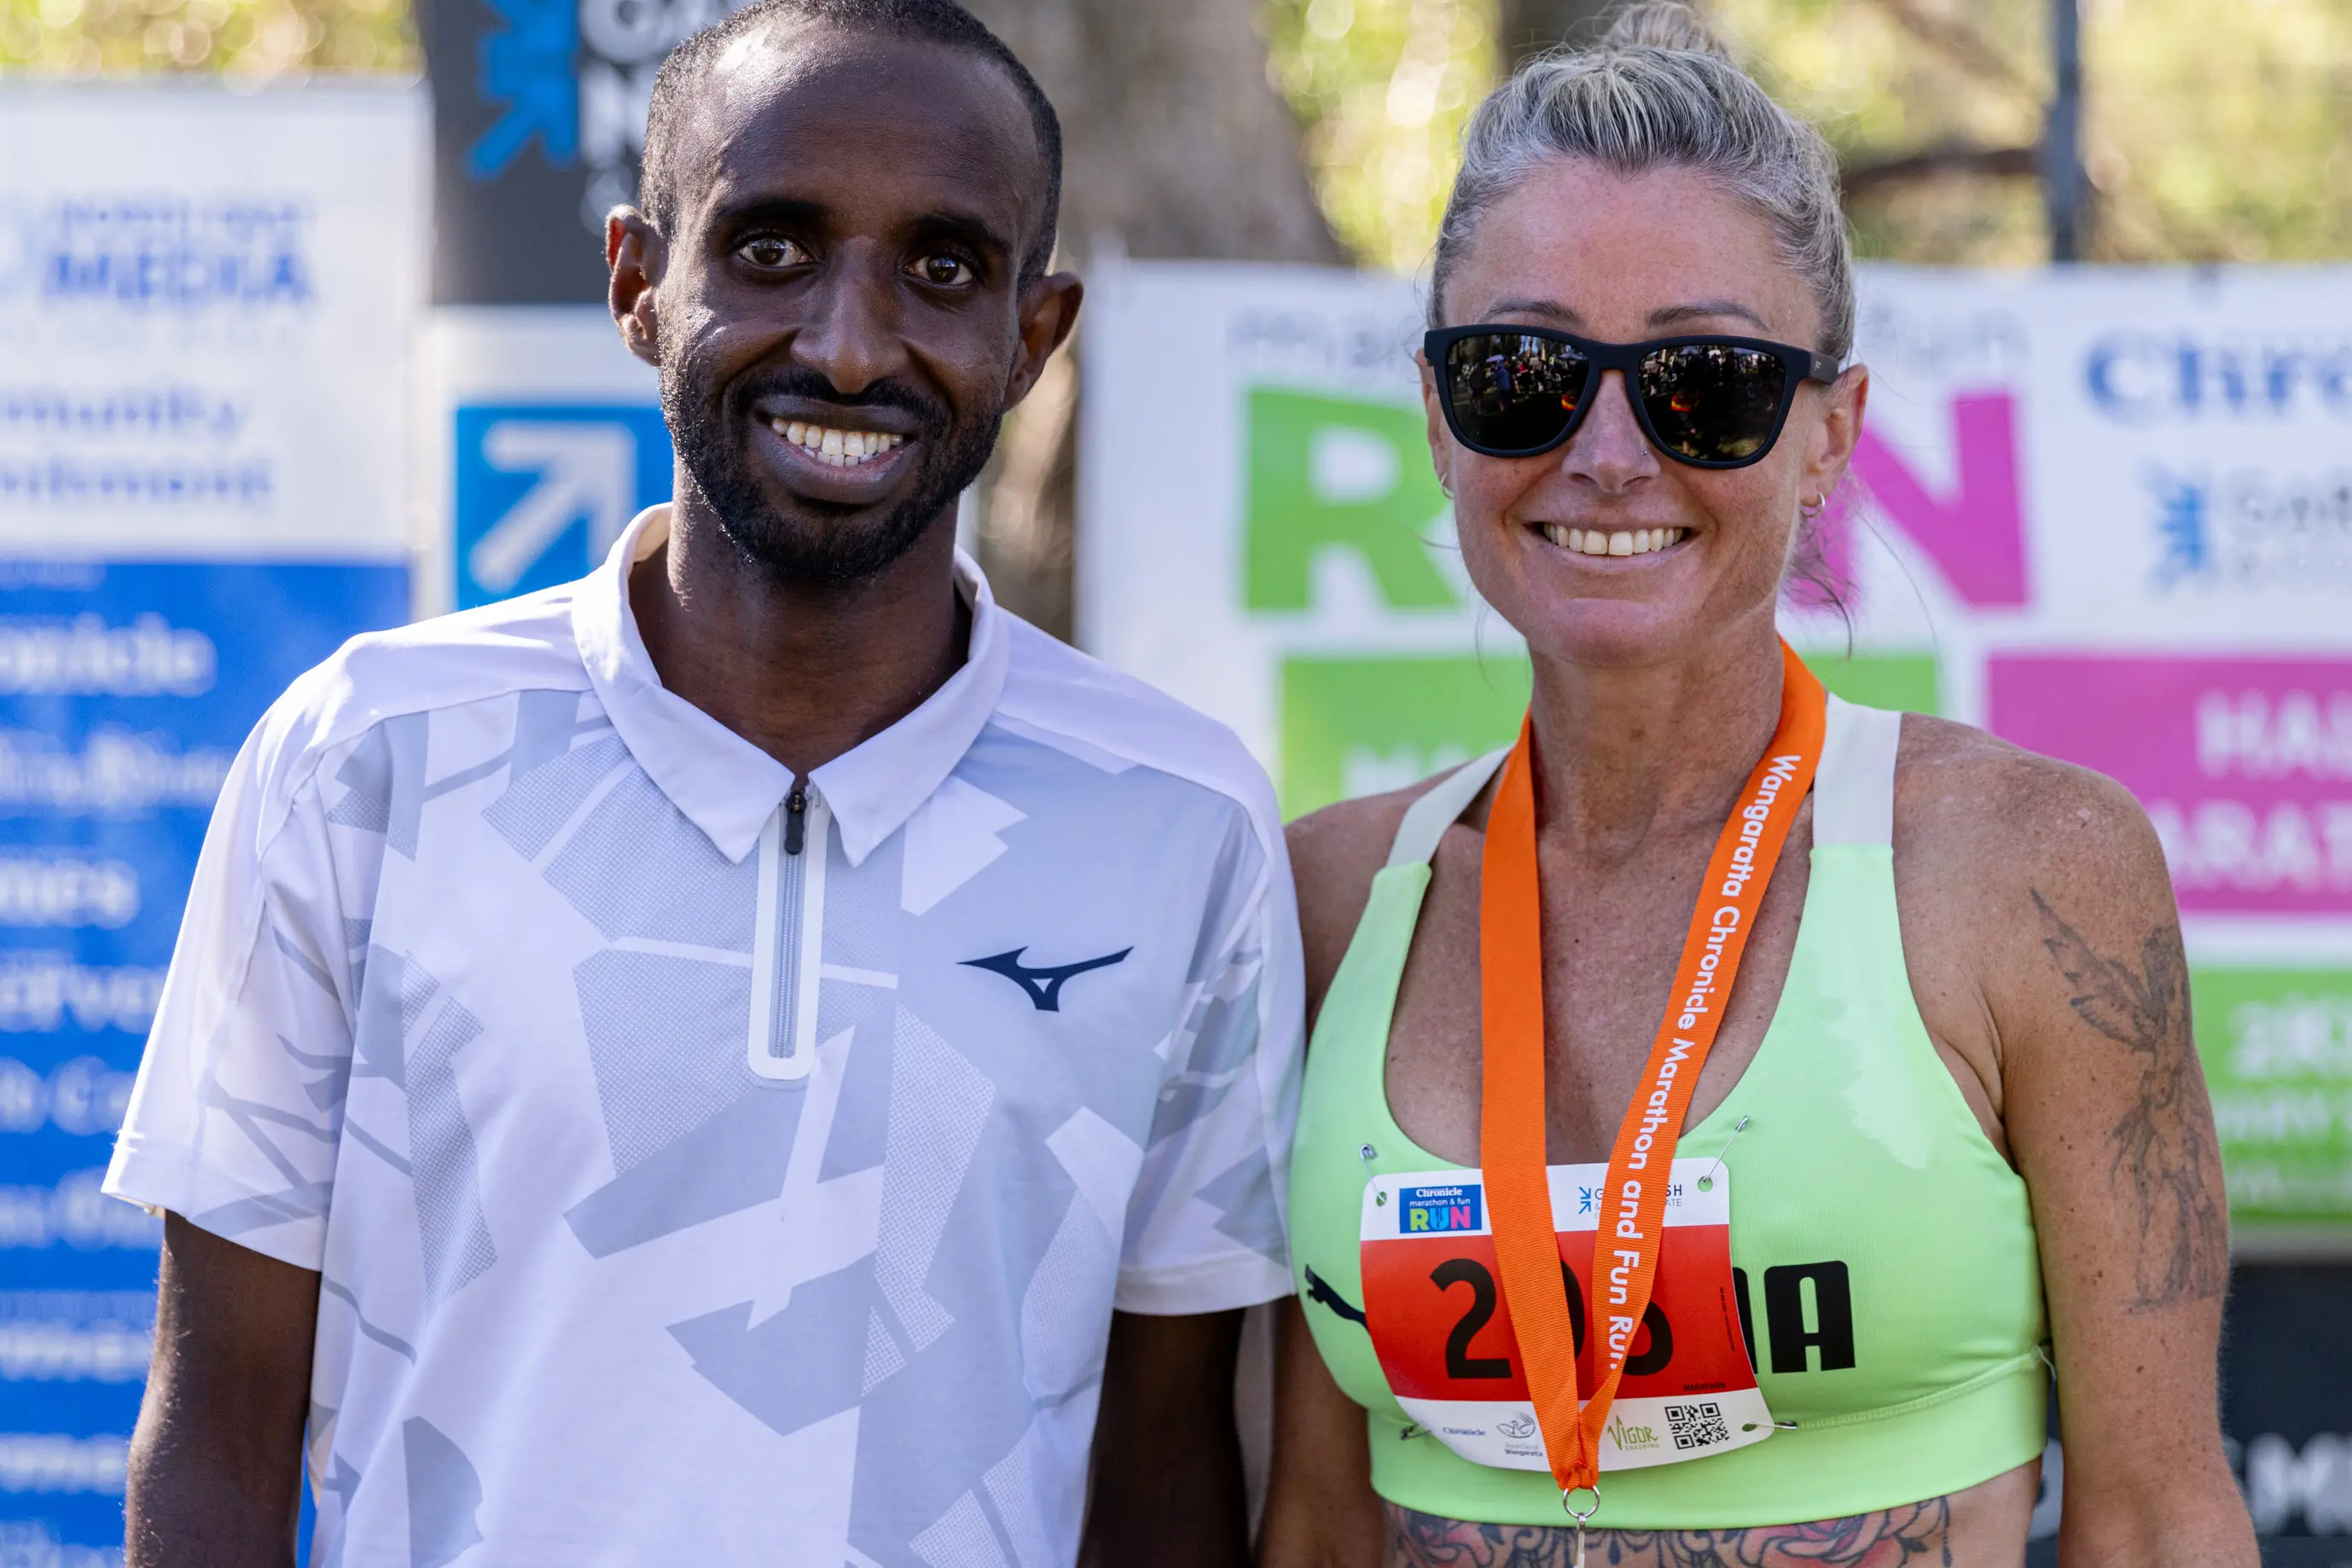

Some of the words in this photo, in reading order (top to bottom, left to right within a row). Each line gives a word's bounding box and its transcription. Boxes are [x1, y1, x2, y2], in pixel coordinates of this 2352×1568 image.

[1246, 384, 2030, 619] RN
[1721, 754, 1802, 897] Wangaratta
[1677, 906, 1740, 1030] Chronicle
[1628, 1037, 1696, 1170] Marathon
[1409, 1199, 1448, 1207] marathon
[1409, 1205, 1472, 1231] RUN
[1416, 1187, 1463, 1198] Chronicle
[1616, 1180, 1643, 1239] and
[1609, 1250, 1640, 1304] Fun
